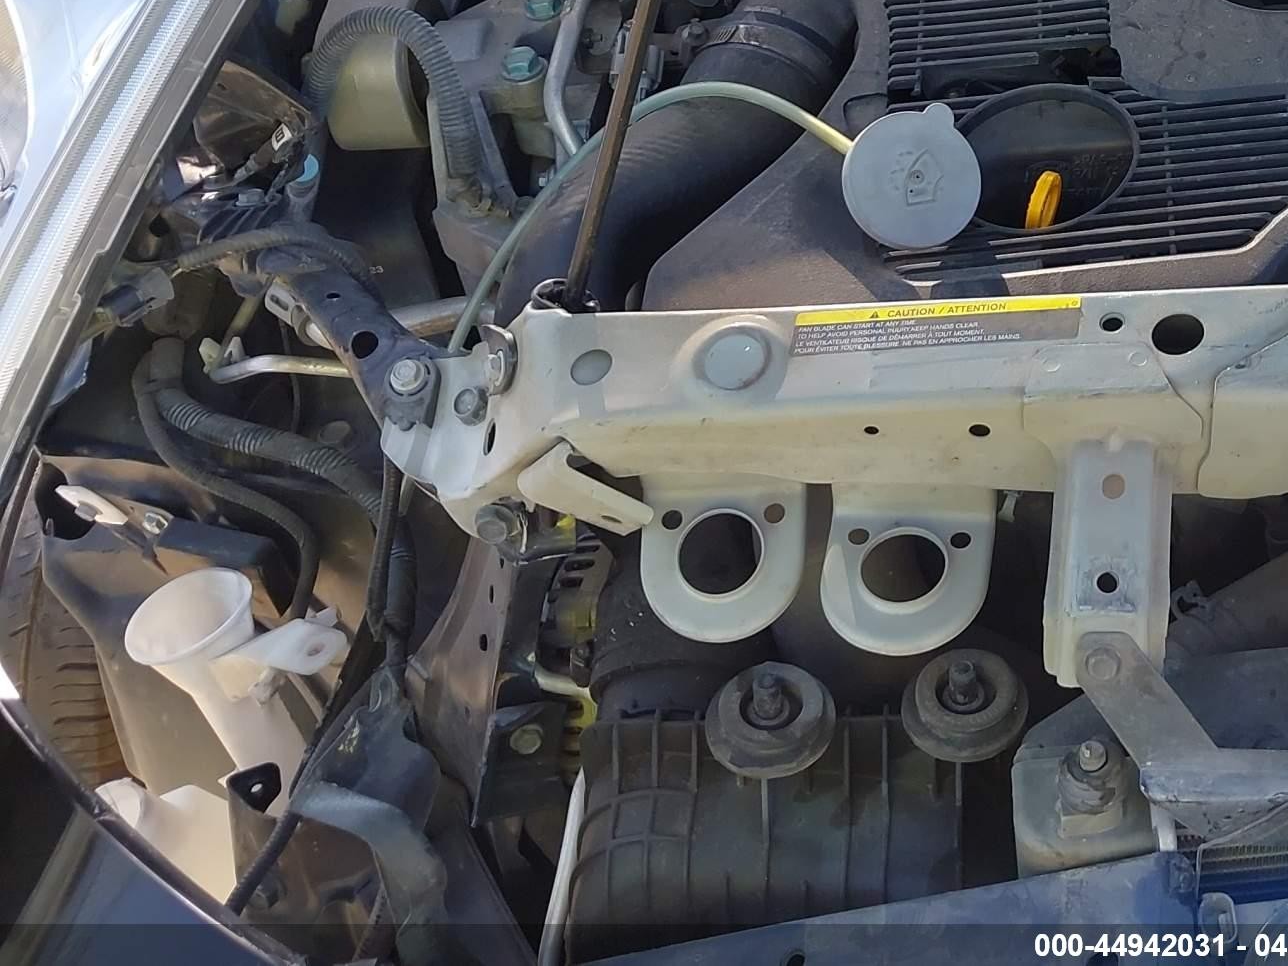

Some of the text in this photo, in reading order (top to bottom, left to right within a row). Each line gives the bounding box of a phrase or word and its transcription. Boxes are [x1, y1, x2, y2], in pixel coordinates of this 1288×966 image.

[887, 307, 936, 318] CAUTION
[947, 302, 1008, 314] ATTENTION
[930, 322, 955, 330] HANDS
